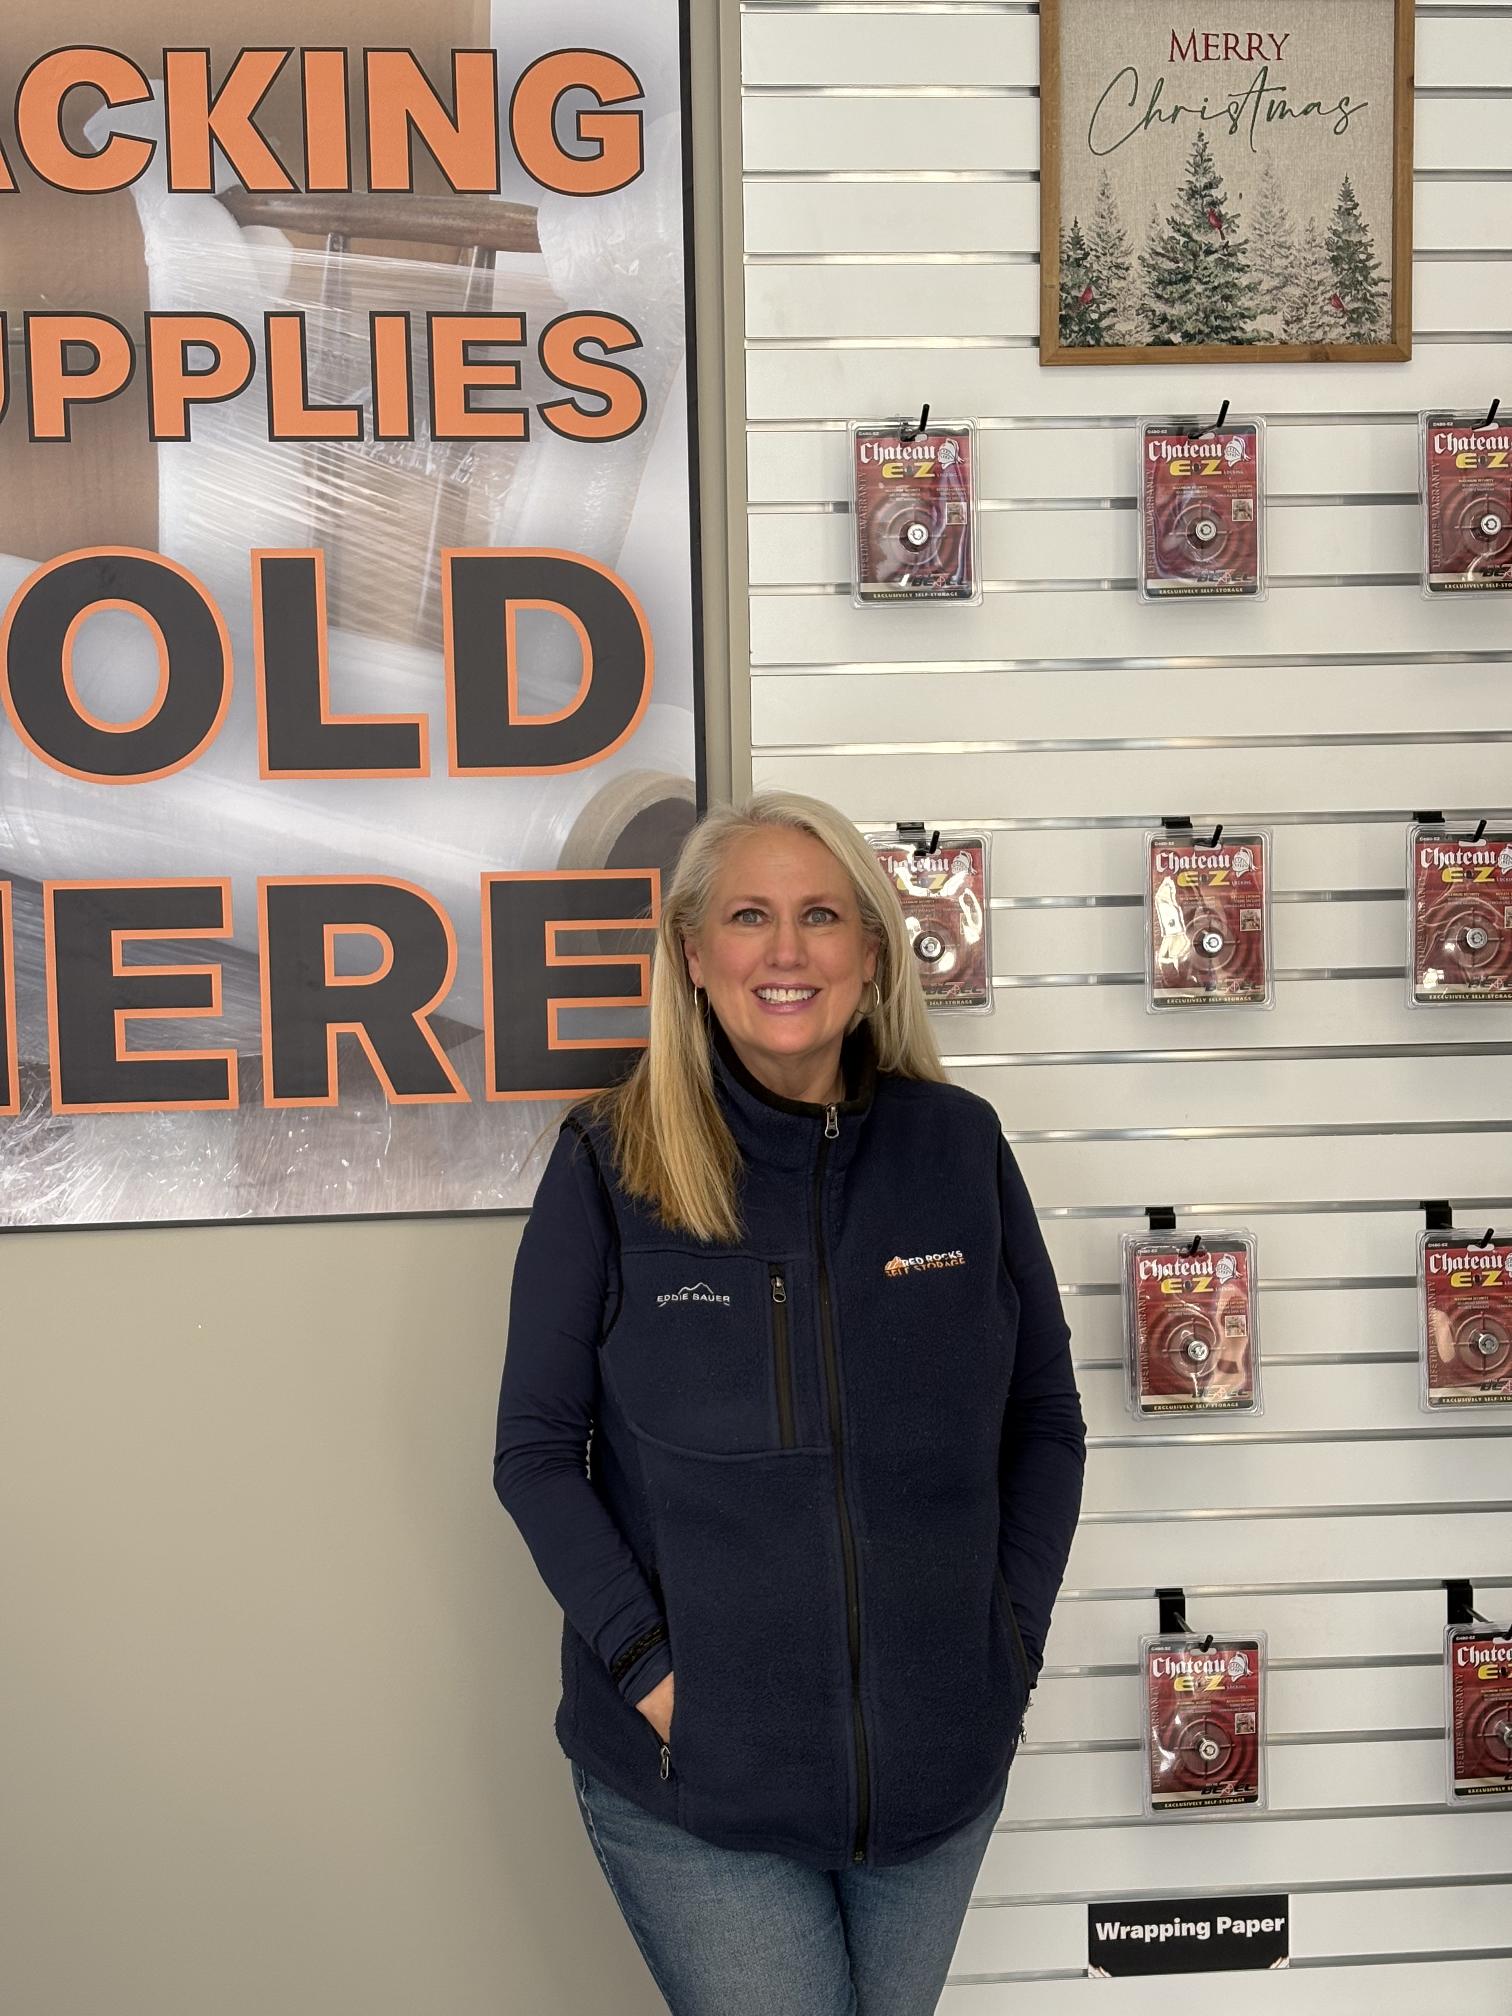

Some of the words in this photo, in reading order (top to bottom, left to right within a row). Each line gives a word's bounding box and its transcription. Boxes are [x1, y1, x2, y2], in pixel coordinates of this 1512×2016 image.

[1168, 28, 1290, 62] MERRY
[1088, 66, 1368, 156] Christmas
[0, 310, 647, 442] PPLIES
[860, 442, 936, 465] Chateau
[1148, 440, 1222, 462] Chateau
[1434, 433, 1510, 456] Chateau
[0, 546, 654, 785] OLD
[1155, 852, 1230, 873] Chateau
[1420, 847, 1496, 870] Chateau
[0, 868, 661, 1115] ERE
[925, 1250, 963, 1262] ROCKS
[1429, 1253, 1503, 1275] Chateau
[1139, 1259, 1214, 1280] Chateau
[656, 1293, 689, 1302] EDDIE
[692, 1293, 730, 1302] BAUER
[1152, 1657, 1225, 1679] Chateau
[1095, 1917, 1211, 1943] Wrapping
[1216, 1916, 1285, 1938] Paper
